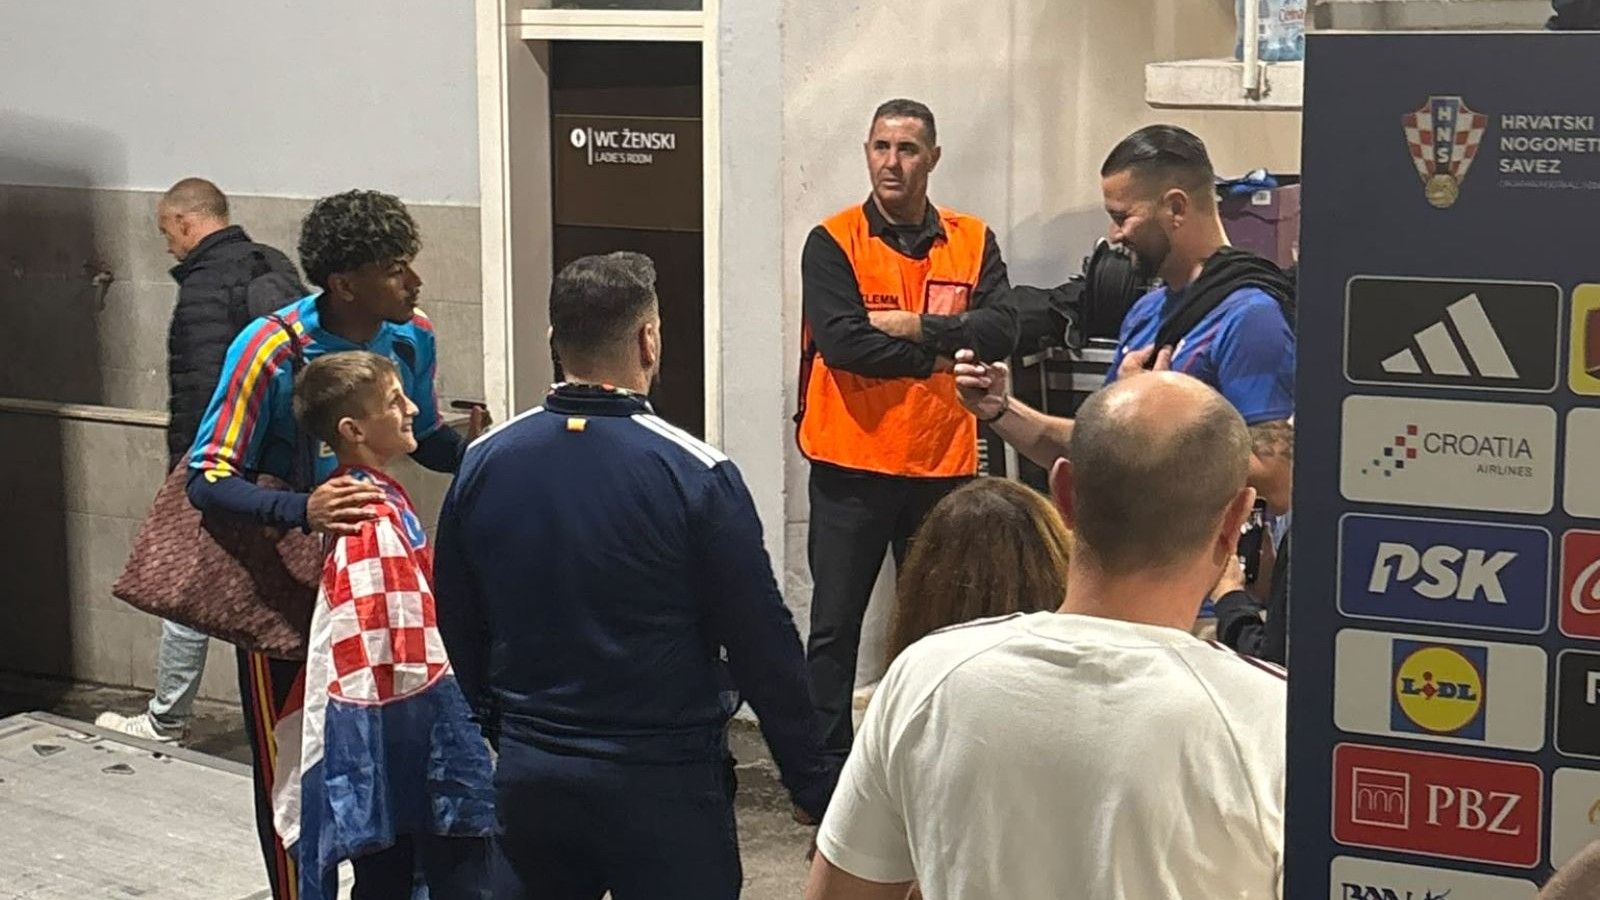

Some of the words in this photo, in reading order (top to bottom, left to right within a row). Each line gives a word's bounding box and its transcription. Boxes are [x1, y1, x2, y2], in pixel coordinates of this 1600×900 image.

[1501, 115, 1594, 130] HRVATSKI
[593, 131, 619, 148] WC
[621, 128, 675, 149] ŽENSKI
[1500, 136, 1600, 153] NOGOMET
[626, 153, 652, 163] ROOM
[1499, 158, 1562, 174] SAVEZ
[862, 293, 899, 305] LEMM
[1423, 433, 1533, 460] CROATIA
[1476, 464, 1533, 478] AIRLINES
[1368, 542, 1519, 604] PSK
[1425, 784, 1522, 836] PBZ
